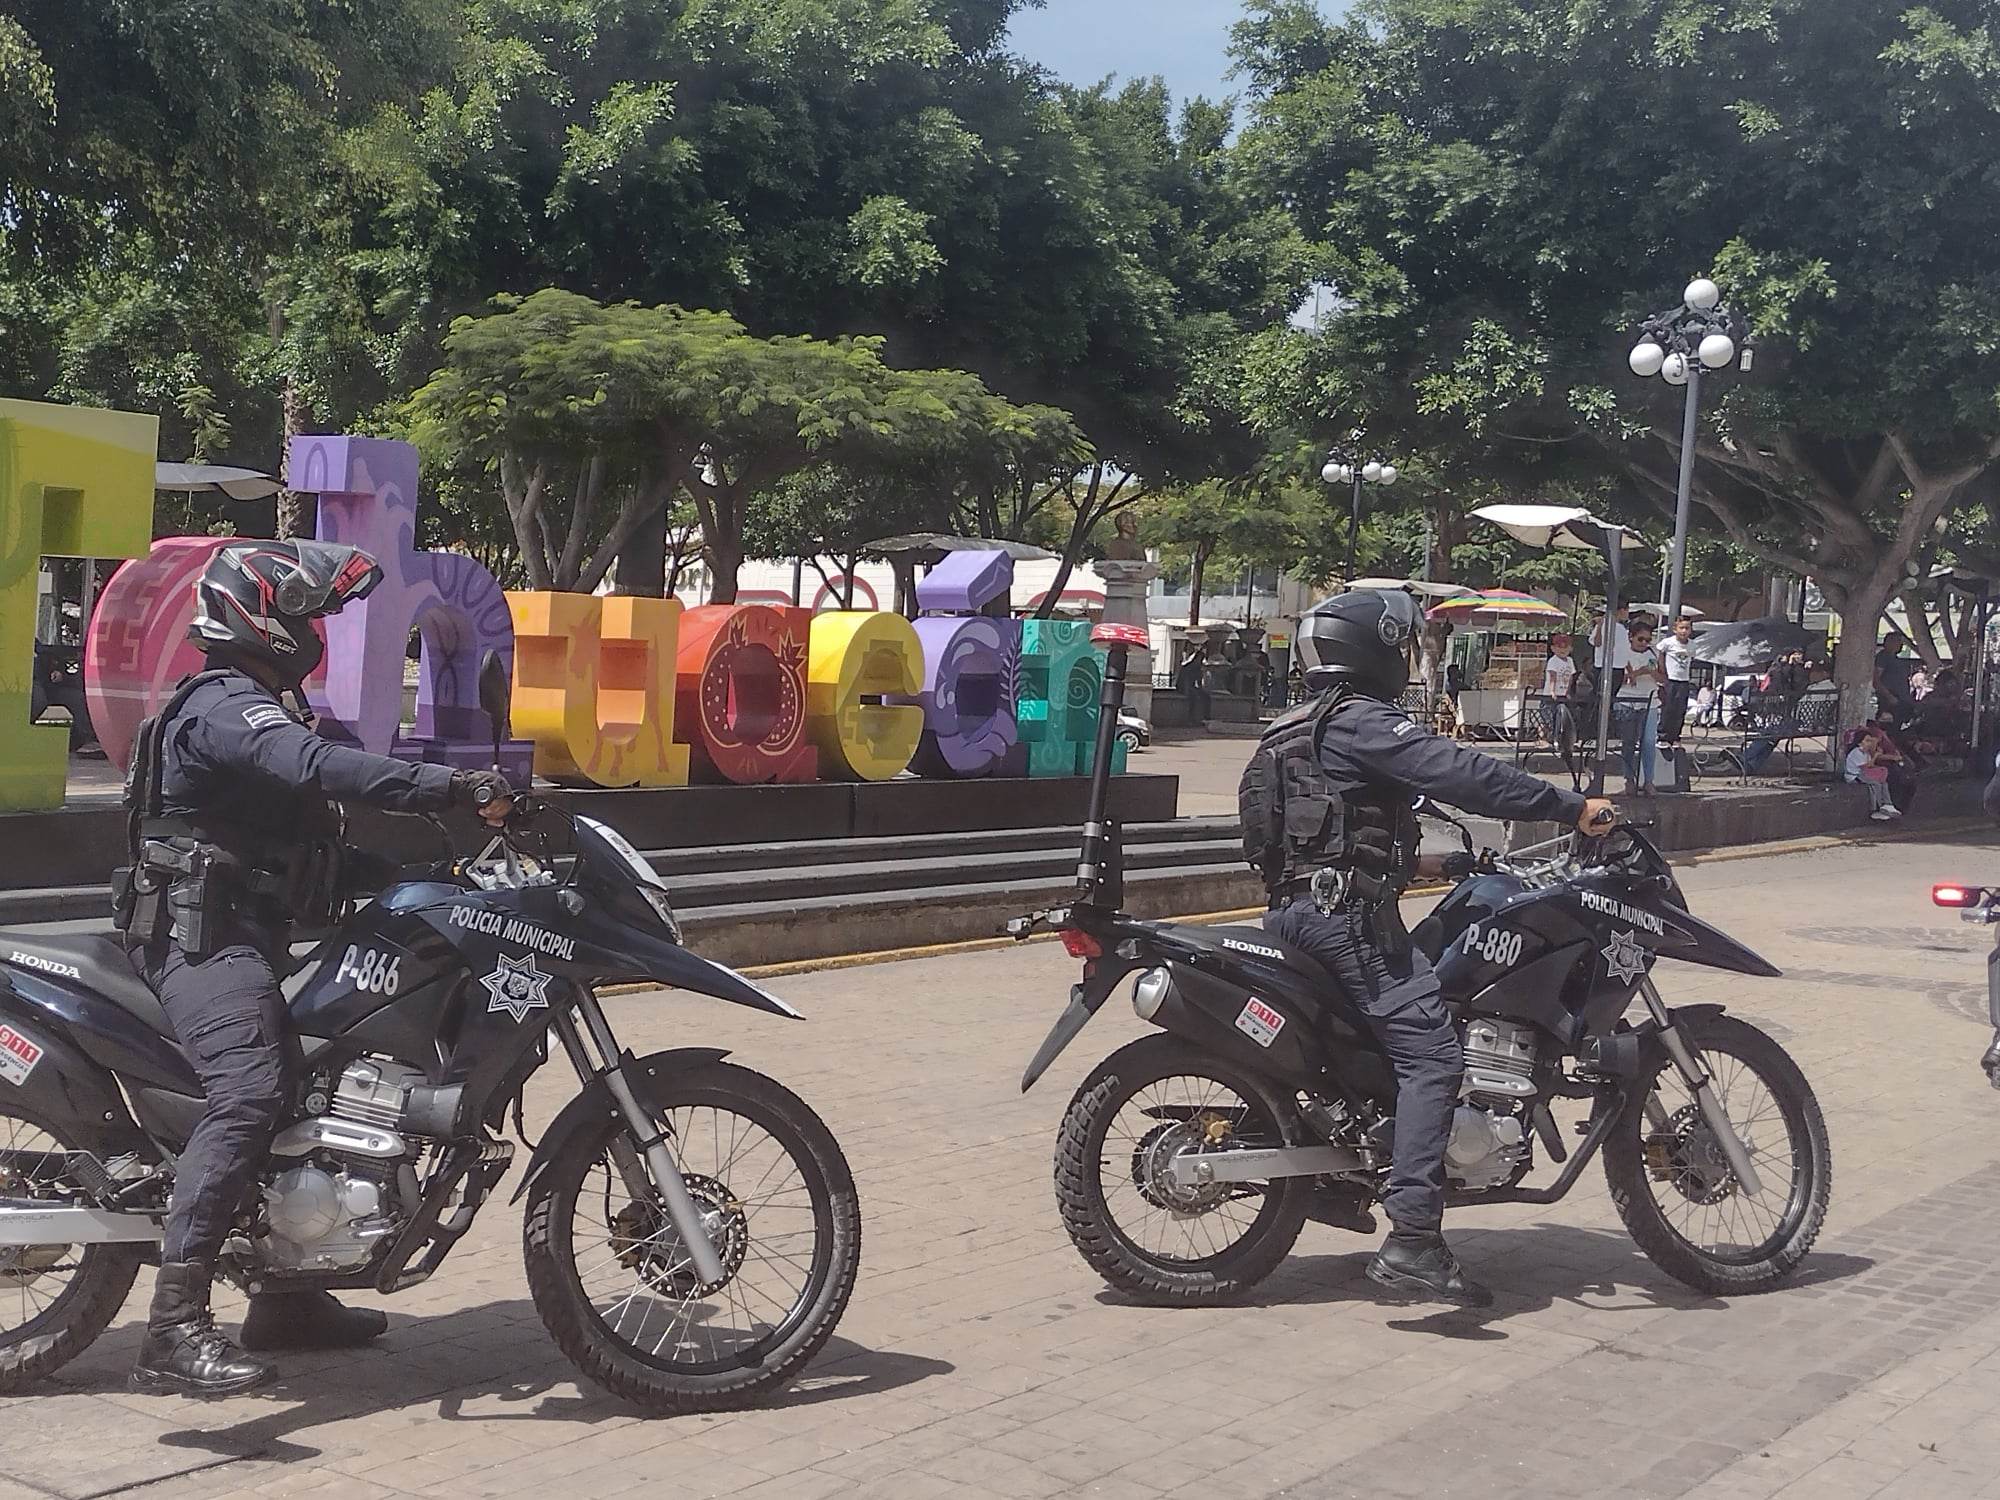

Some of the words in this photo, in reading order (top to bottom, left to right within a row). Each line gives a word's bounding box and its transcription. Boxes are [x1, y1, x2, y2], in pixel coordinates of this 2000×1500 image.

[1580, 891, 1618, 917] POLICIA
[1619, 903, 1664, 937] MUNICIPAL
[448, 905, 502, 937] POLICIA
[501, 918, 576, 961] MUNICIPAL
[1222, 938, 1285, 960] HONDA
[1462, 923, 1522, 967] P-880
[9, 951, 81, 979] HONDA
[334, 944, 401, 996] P-866
[1250, 1002, 1279, 1027] 911
[0, 1031, 36, 1060] 911
